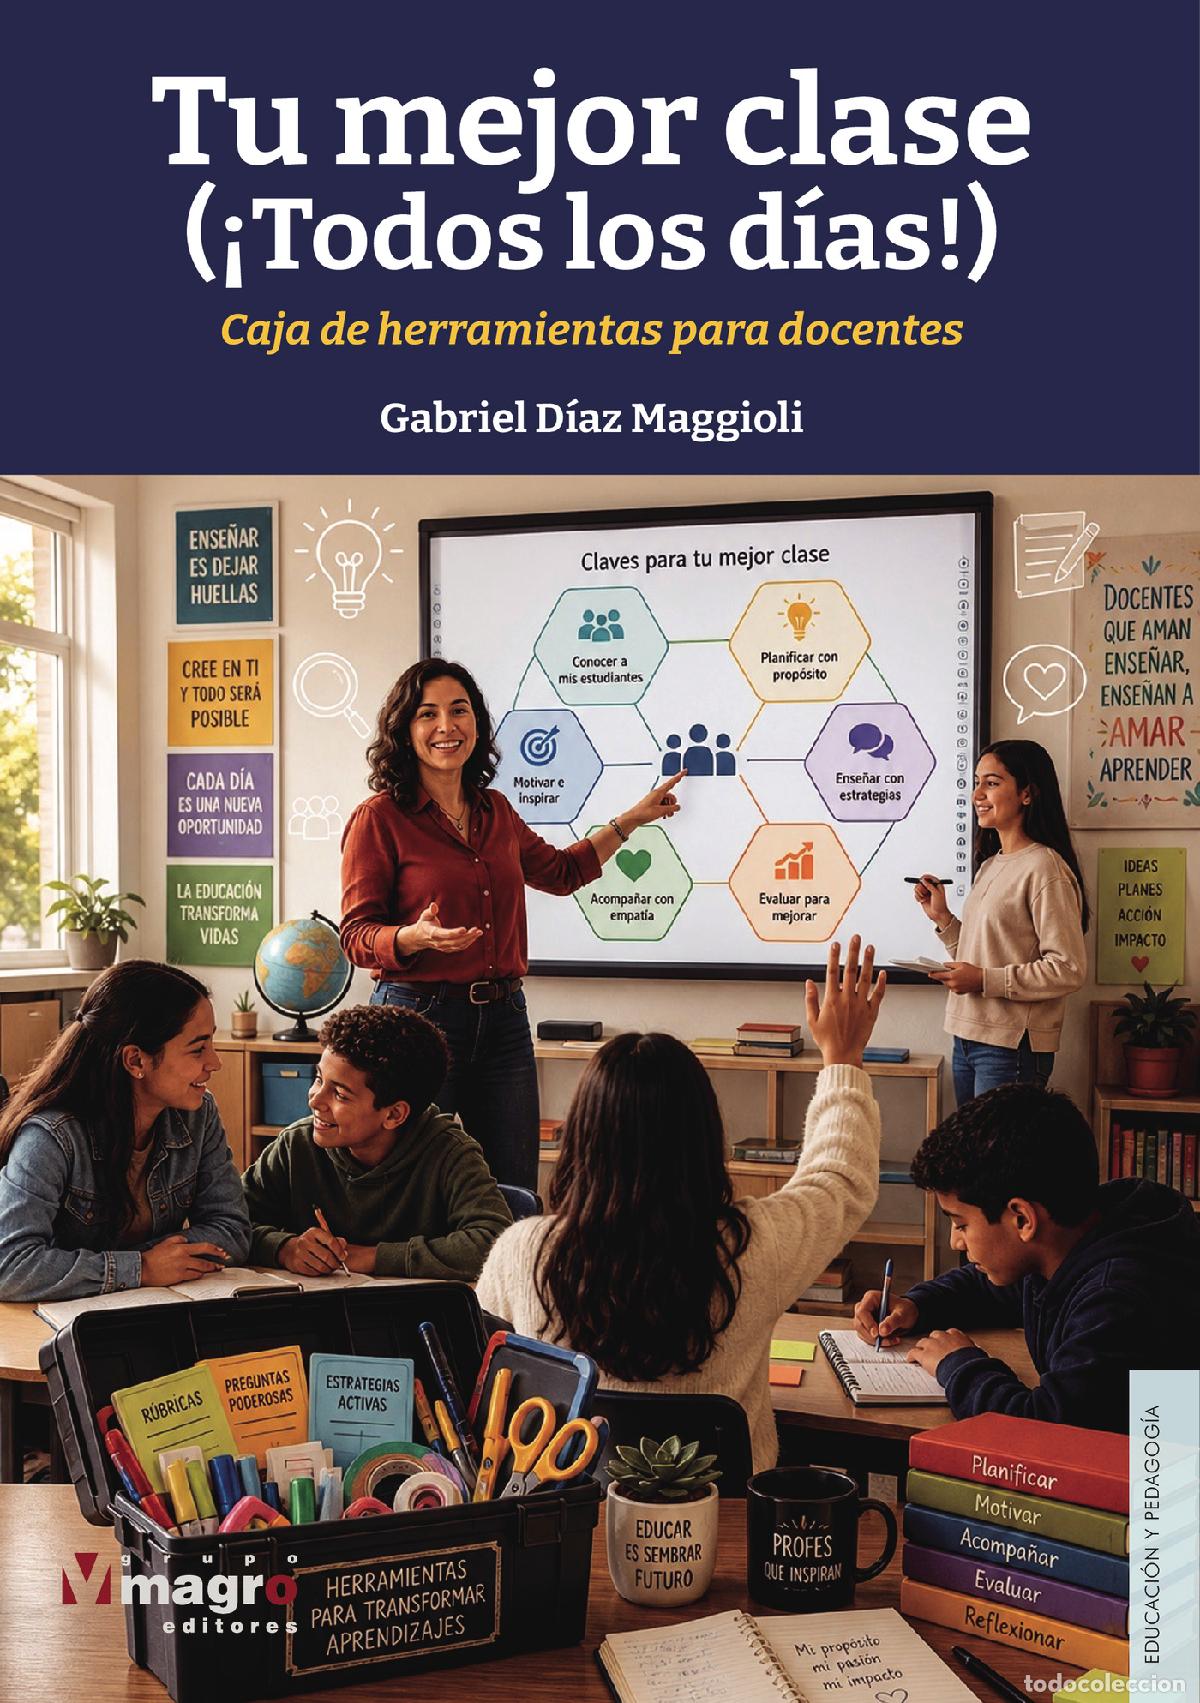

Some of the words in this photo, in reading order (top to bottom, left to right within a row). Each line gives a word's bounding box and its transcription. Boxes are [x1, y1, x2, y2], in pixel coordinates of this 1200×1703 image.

[190, 524, 259, 549] ENSEÑAR
[190, 559, 208, 578] ES
[212, 556, 258, 577] DEJAR
[581, 549, 640, 571] Claves
[646, 551, 687, 572] para
[693, 549, 714, 567] tu
[719, 547, 774, 570] mejor
[781, 546, 830, 564] clase
[191, 582, 258, 604] HUELLAS
[1104, 584, 1194, 611] DOCENTES
[1103, 619, 1137, 643] QUE
[1142, 617, 1191, 640] AMAN
[572, 655, 616, 668] Conocer
[620, 659, 628, 667] a
[761, 650, 813, 664] Planificar
[817, 654, 838, 664] con
[1104, 647, 1190, 675] ENSEÑAR,
[183, 660, 219, 678] CREE
[224, 660, 241, 677] EN
[247, 659, 258, 676] TI
[558, 672, 577, 684] mis
[580, 670, 643, 684] estudiantes
[181, 686, 189, 701] Y
[192, 686, 225, 702] TODO
[230, 681, 261, 701] SERÁ
[1101, 680, 1177, 707] ENSEÑAN
[1181, 683, 1194, 705] A
[191, 709, 249, 728] POSIBLE
[1109, 716, 1186, 747] AMAR
[187, 772, 225, 791] CADA
[230, 767, 254, 790] DÍA
[836, 772, 879, 785] Enseñar
[883, 775, 904, 785] con
[1100, 756, 1193, 782] APRENDER
[513, 775, 553, 788] Motivar
[557, 779, 565, 788] e
[178, 797, 192, 813] ES
[196, 797, 220, 813] UNA
[224, 796, 263, 813] NUEVA
[519, 791, 560, 806] inspirar
[839, 788, 901, 803] estrategias
[178, 818, 263, 835] OPORTUNIDAD
[1124, 859, 1158, 873] IDEAS
[177, 884, 192, 899] LA
[196, 880, 262, 900] EDUCACIÓN
[1118, 882, 1163, 896] PLANES
[590, 893, 651, 907] Acompañar
[654, 896, 674, 905] con
[759, 893, 799, 906] Evaluar
[803, 896, 830, 908] para
[181, 906, 258, 921] TRANSFORMA
[610, 909, 654, 924] empatía
[772, 911, 816, 924] mejorar
[1119, 904, 1162, 922] ACCIÓN
[201, 928, 238, 945] VIDAS
[1114, 932, 1166, 947] IMPACTO
[224, 1369, 291, 1393] PREGUNTAS
[326, 1375, 400, 1393] ESTRATEGIAS
[141, 1390, 203, 1424] RÚBRICAS
[229, 1389, 293, 1413] PODEROSAS
[338, 1396, 387, 1412] ACTIVAS
[972, 1455, 1058, 1490] Planificar
[976, 1494, 1042, 1525] Motivar
[636, 1518, 692, 1540] EDUCAR
[626, 1544, 640, 1562] ES
[644, 1542, 702, 1562] SEMBRAR
[773, 1532, 832, 1558] PROFES
[960, 1528, 1060, 1570] Acompañar
[325, 1559, 468, 1599] HERRAMIENTAS
[634, 1569, 694, 1590] FUTURO
[764, 1561, 785, 1582] QUE
[790, 1562, 842, 1584] INSPIRAN
[975, 1570, 1042, 1603] Evaluar
[311, 1605, 357, 1629] PARA
[363, 1584, 485, 1623] TRANSFORMAR
[326, 1615, 465, 1656] APRENDIZAJES
[964, 1607, 1065, 1651] Reflexionar
[795, 1643, 816, 1657] Mi
[812, 1659, 831, 1673] mi
[836, 1654, 881, 1674] pasión
[823, 1676, 843, 1690] mi
[848, 1668, 903, 1690] impacto
